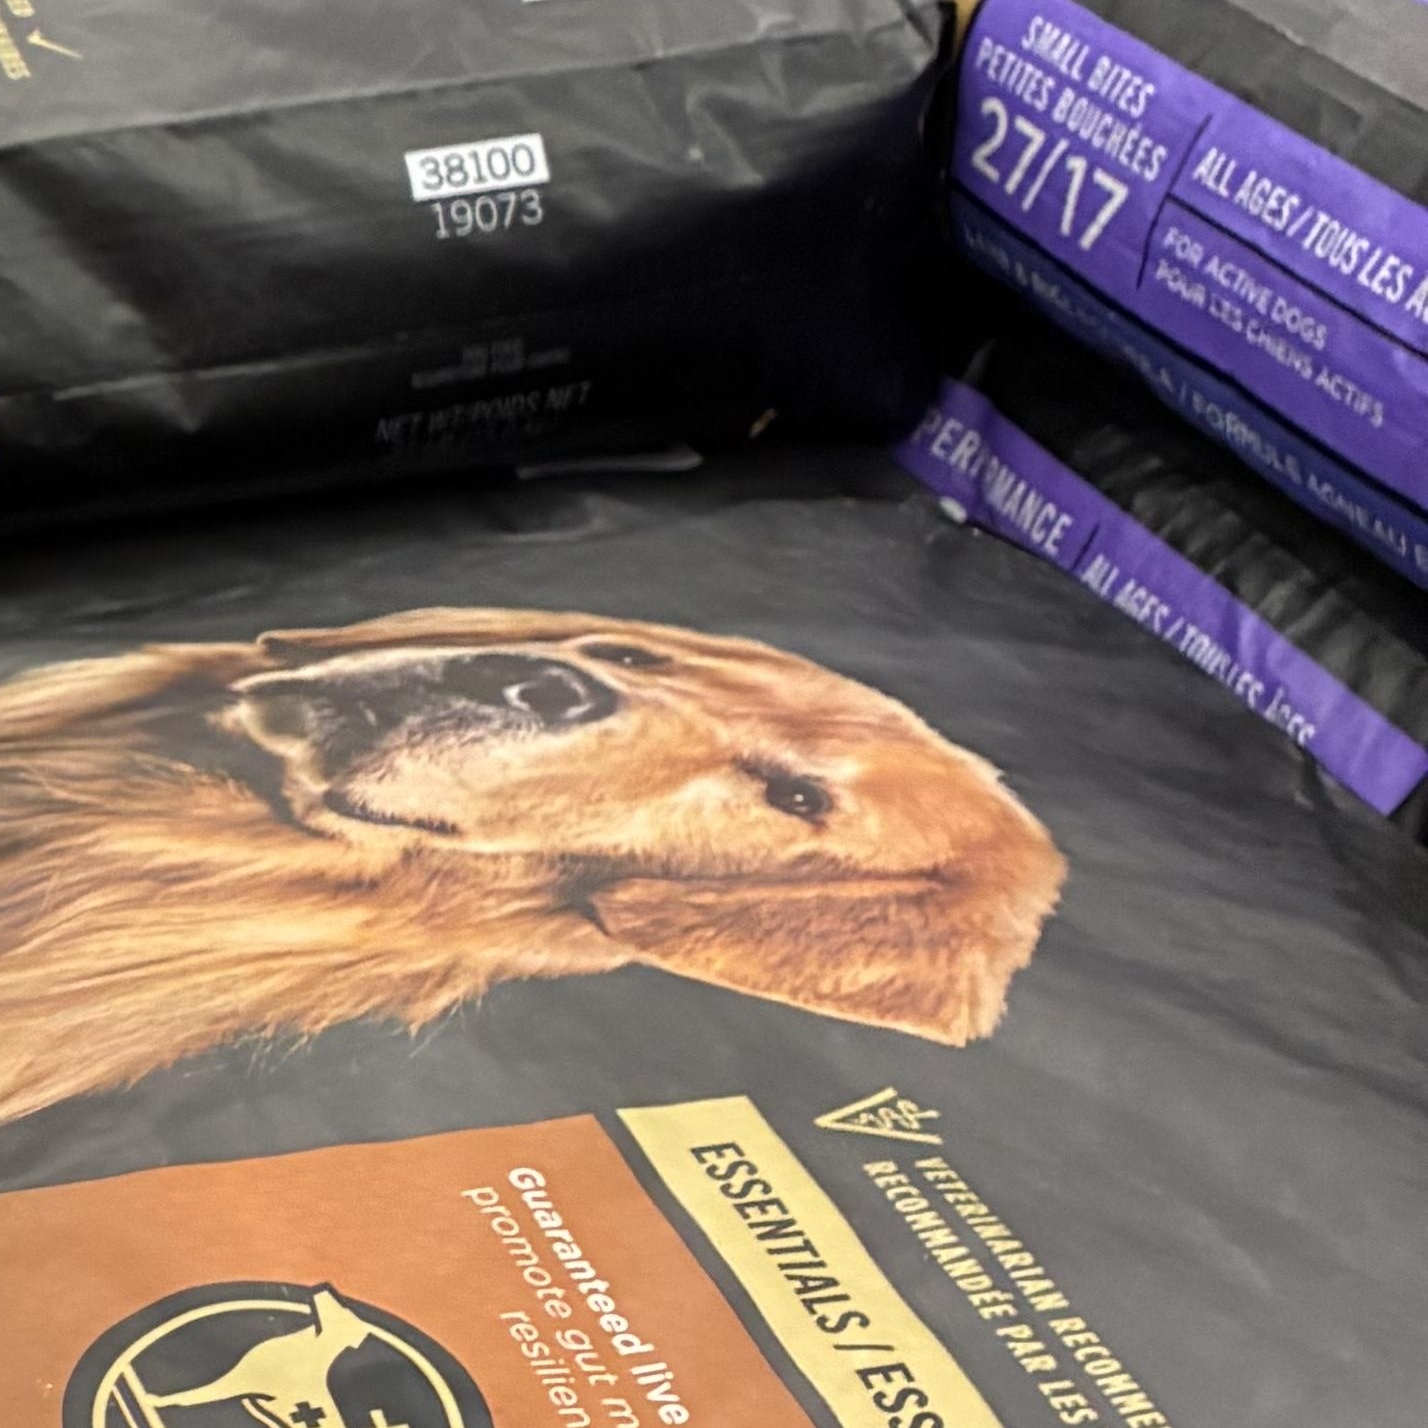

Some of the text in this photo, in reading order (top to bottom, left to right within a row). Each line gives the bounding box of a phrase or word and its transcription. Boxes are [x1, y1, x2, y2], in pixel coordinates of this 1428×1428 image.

[976, 36, 1169, 183] PETITES BOUCHÉES
[1019, 15, 1155, 120] SMALL BITES
[418, 142, 535, 191] 38100
[430, 188, 545, 240] 19073
[970, 95, 1130, 252] 27/17
[1192, 145, 1234, 199] ALL
[1234, 170, 1303, 237] AGES
[1301, 209, 1369, 277] TOUS
[1355, 247, 1414, 304] LES
[1155, 261, 1208, 303] POUR
[1314, 364, 1386, 429] ACTIFS
[1161, 226, 1328, 352] FOR ACTIVE DOGS
[911, 408, 1075, 559] PERMANCE
[462, 1184, 577, 1324] promote
[559, 1324, 622, 1389] gut
[506, 1165, 654, 1358] Guaranteed
[630, 1356, 692, 1428] live
[688, 1140, 872, 1337] ESSENTIALS
[862, 1158, 1021, 1323] RECOMMANDÉE
[994, 1319, 1048, 1376] PAR
[911, 1154, 1072, 1314] VETERINARIAN
